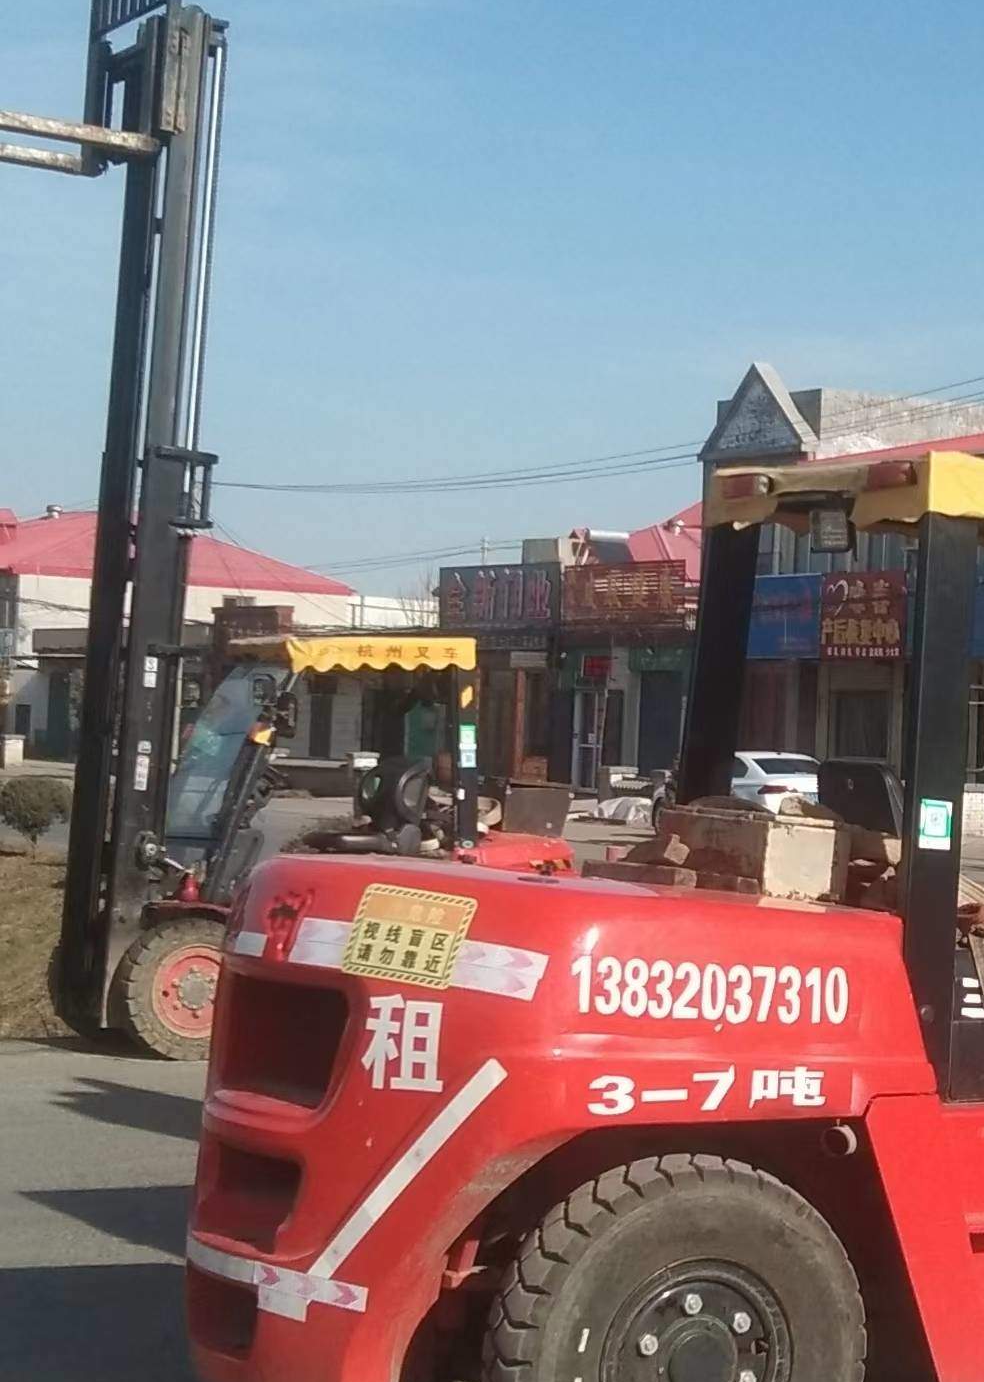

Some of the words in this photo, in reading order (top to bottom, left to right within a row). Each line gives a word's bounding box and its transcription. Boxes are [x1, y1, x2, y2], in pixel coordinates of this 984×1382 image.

[356, 644, 459, 660] 杭州叉车
[363, 921, 449, 951] 视线盲区
[356, 943, 442, 973] 请勿靠近
[570, 955, 849, 1024] 13832037310
[360, 993, 444, 1093] 租
